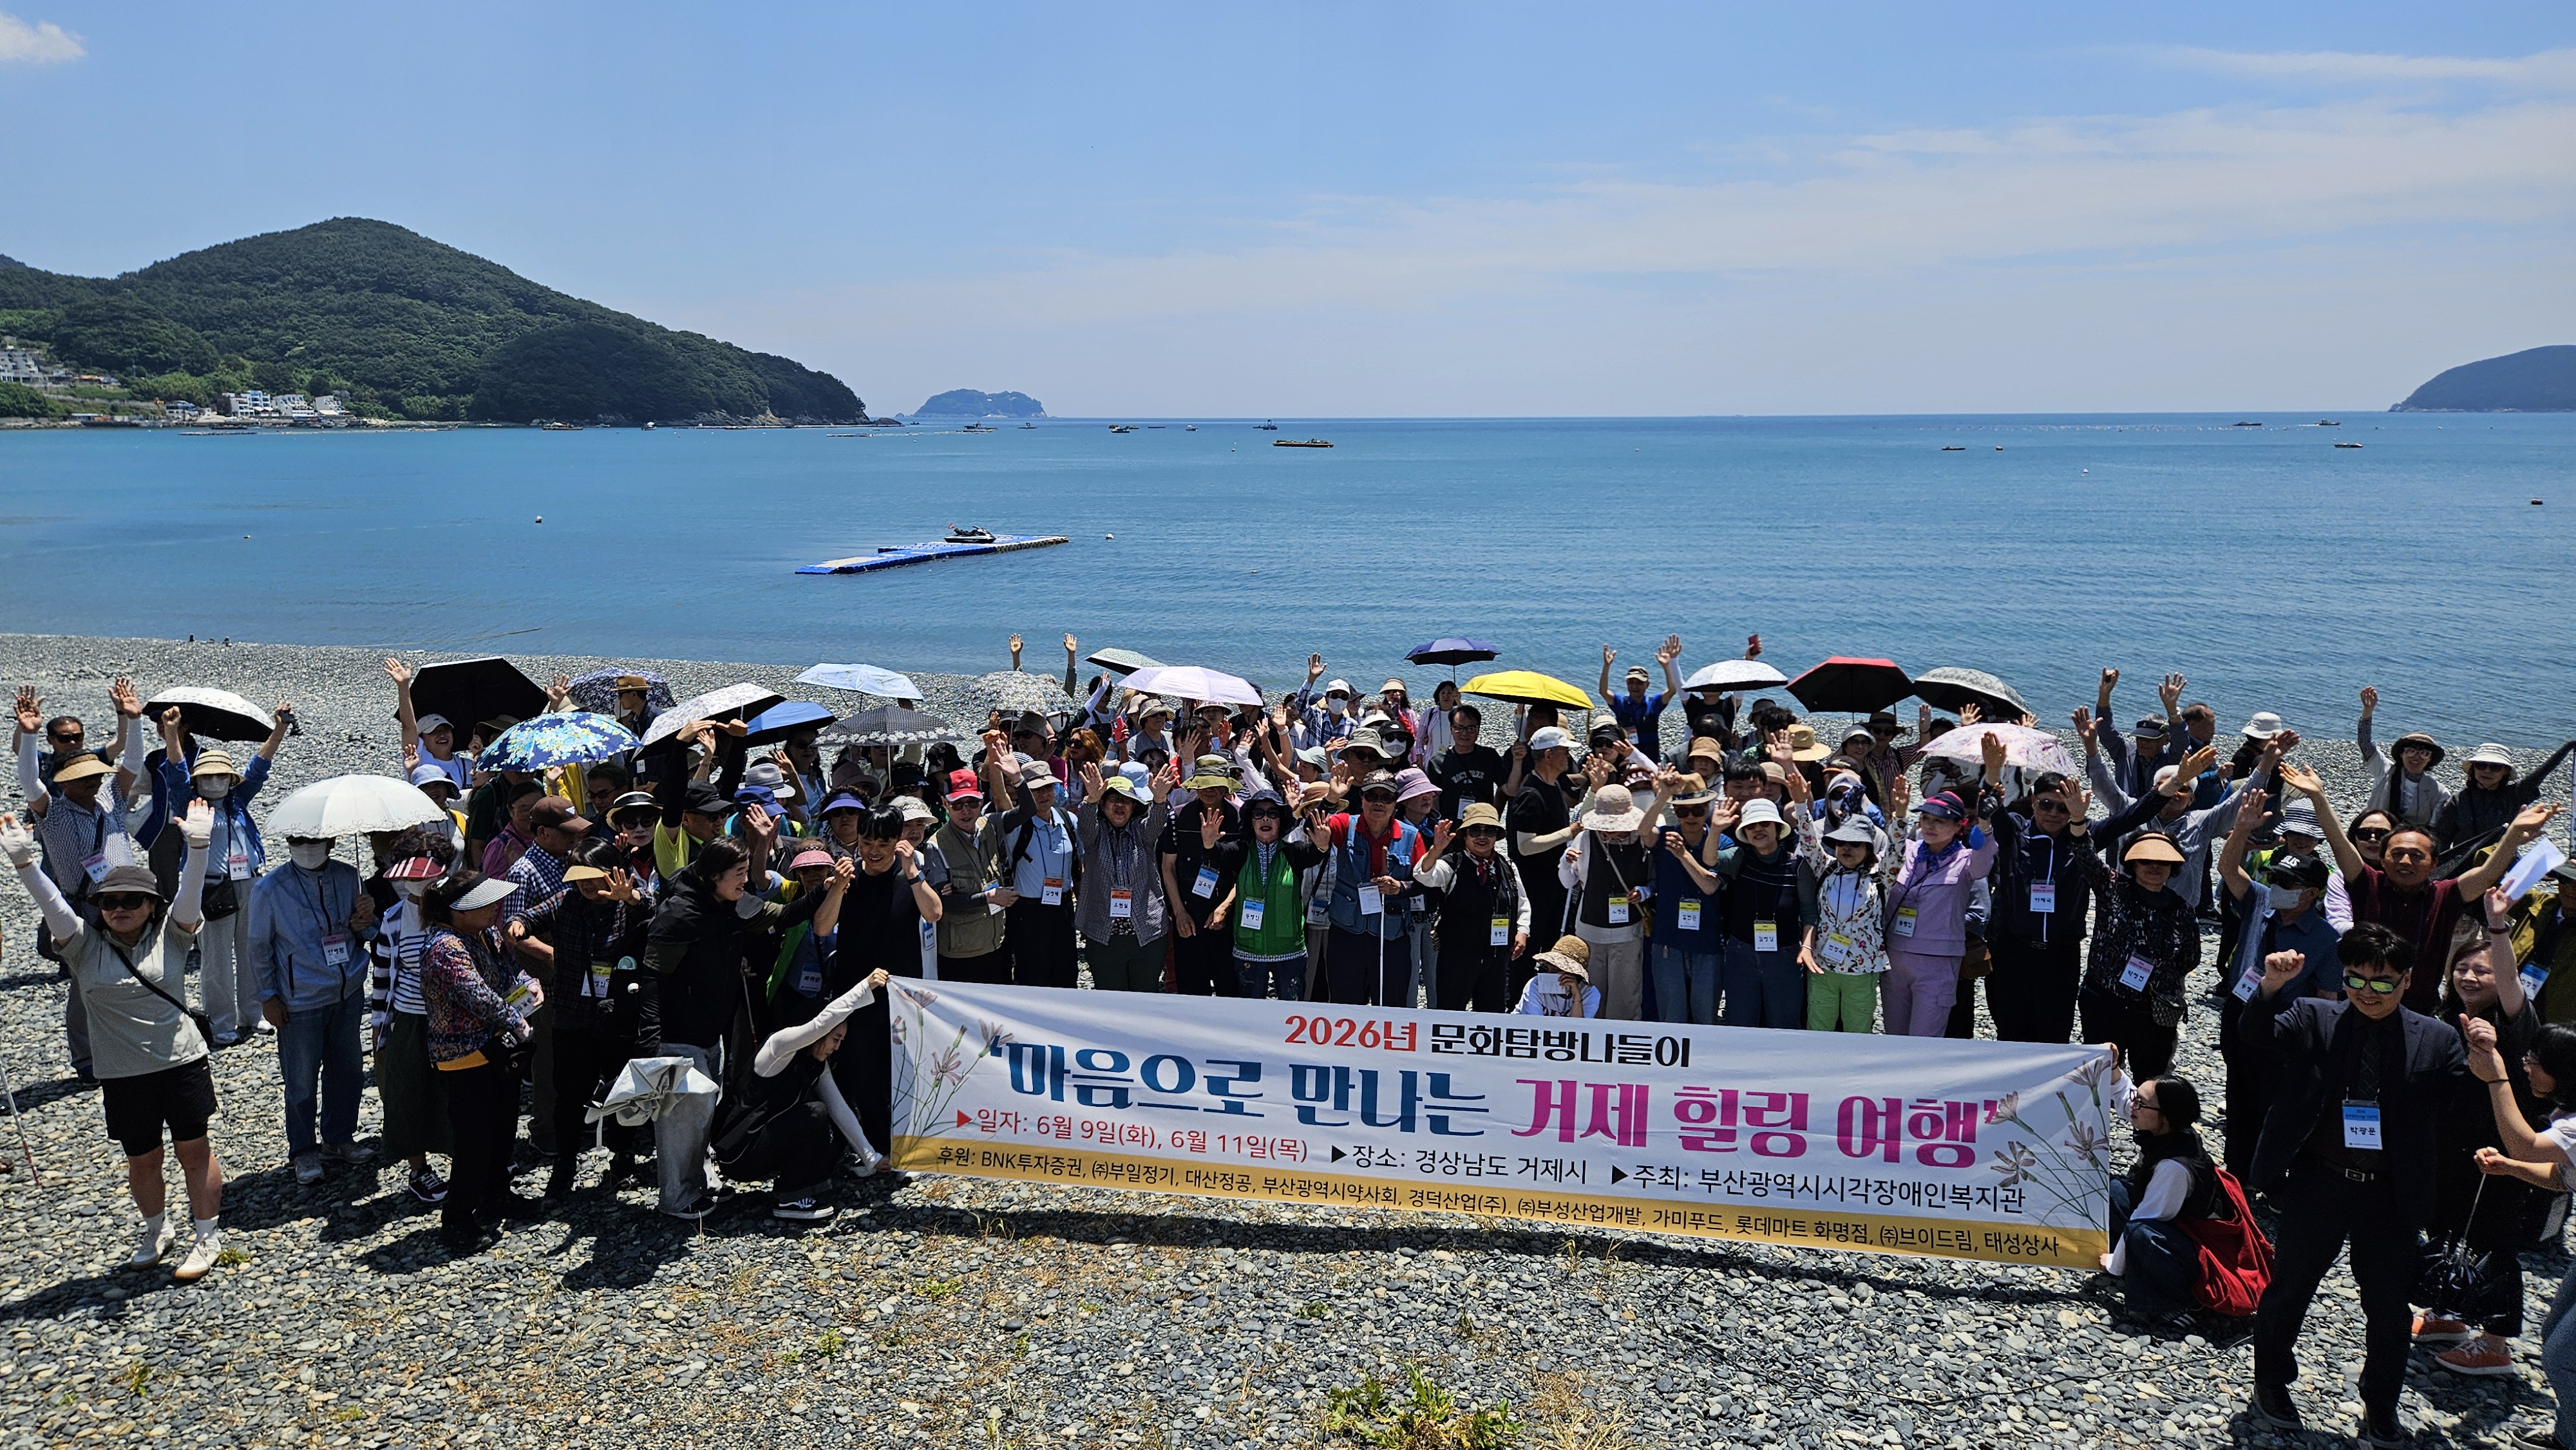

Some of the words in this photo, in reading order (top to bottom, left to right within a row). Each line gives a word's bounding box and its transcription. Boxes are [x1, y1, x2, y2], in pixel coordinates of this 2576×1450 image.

[1285, 1015, 1417, 1051] 2026년
[1431, 1024, 1690, 1068] 문화탐방나들이
[977, 1109, 1028, 1135] 일자:
[1037, 1115, 1072, 1140] 6월
[1081, 1120, 1162, 1149] 9일(화),
[1171, 1130, 1207, 1153] 6월
[1217, 1135, 1307, 1163] 11일(목)
[1289, 1064, 1489, 1136] 만나는
[1511, 1079, 1649, 1147] 거제
[1674, 1086, 1809, 1158] 힐링
[1352, 1145, 1405, 1168] 장소:
[1416, 1150, 1509, 1177] 경상남도
[1517, 1156, 1587, 1185] 거제시
[1633, 1164, 1689, 1191] 주최:
[1698, 1169, 2026, 1214] 부산광역시시각장애인복지관
[937, 1145, 976, 1166] 후원:
[981, 1151, 1086, 1179] BNK투자증권,
[1186, 1169, 1256, 1194] 대산정공,
[1262, 1176, 1402, 1205] 부산광역시약사회,
[1408, 1189, 1511, 1215] 경덕산업(주),
[1653, 1209, 1728, 1234] 가미푸드,
[1735, 1215, 1808, 1238] 롯데마트
[1813, 1220, 1873, 1245] 화명점,
[1984, 1231, 2060, 1257] 태성상사
